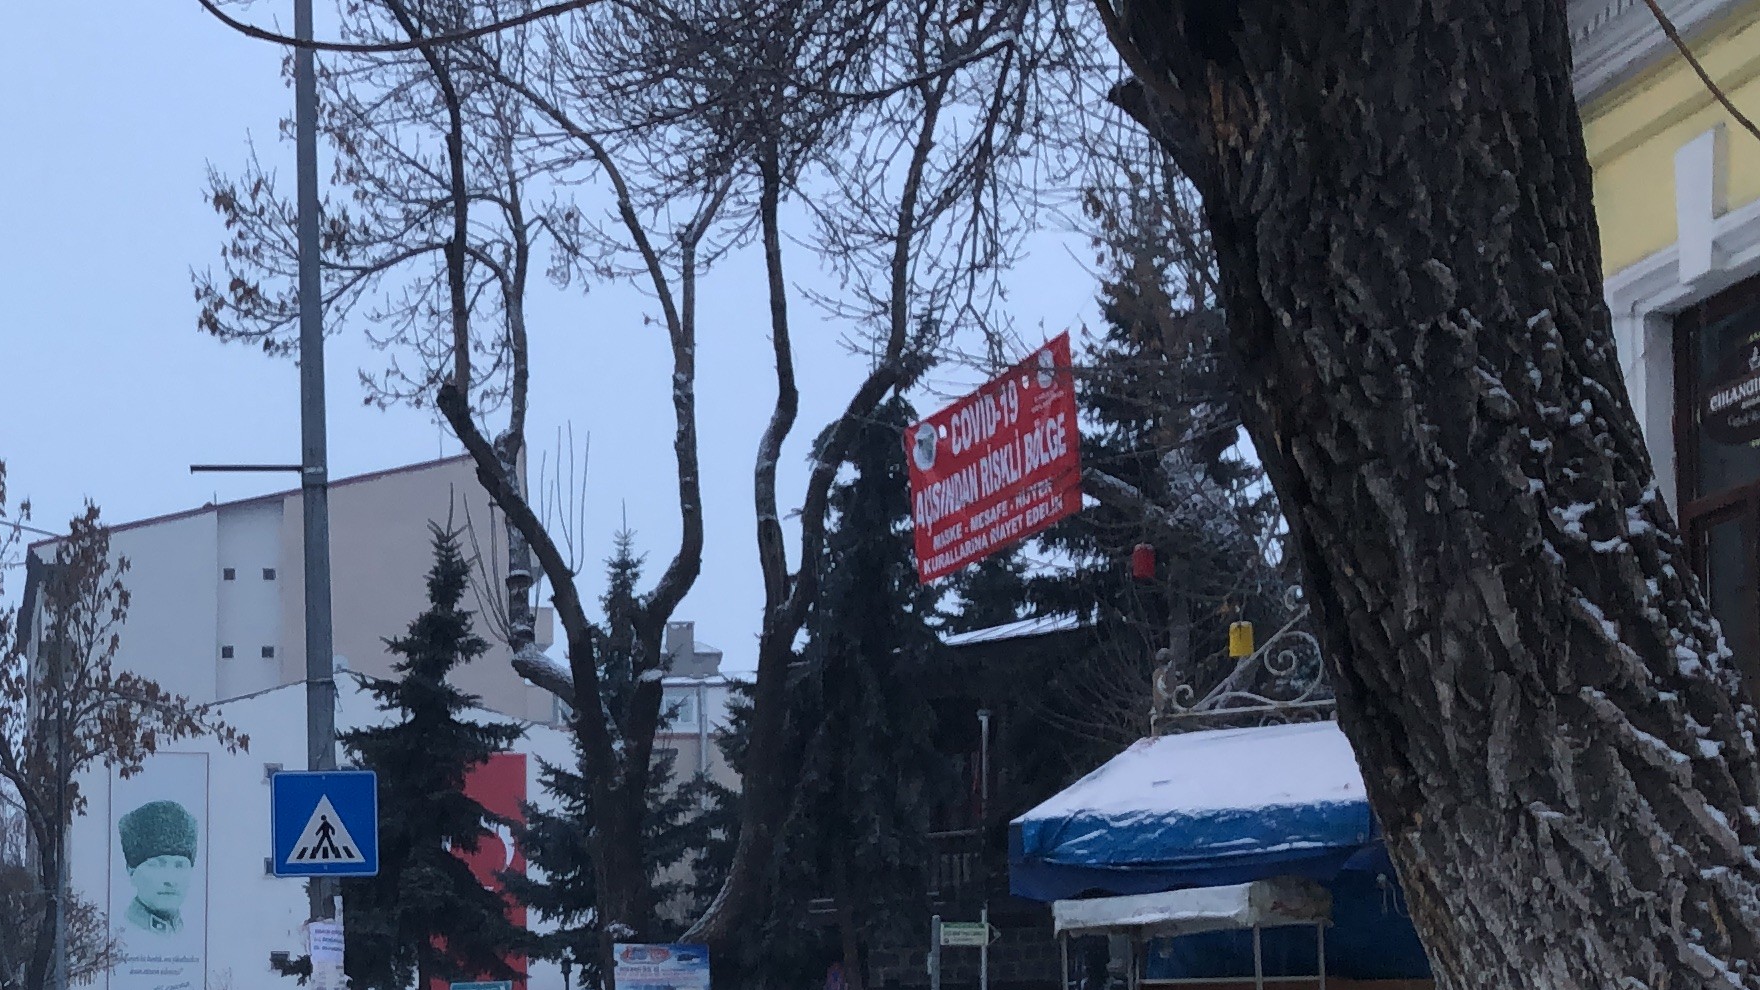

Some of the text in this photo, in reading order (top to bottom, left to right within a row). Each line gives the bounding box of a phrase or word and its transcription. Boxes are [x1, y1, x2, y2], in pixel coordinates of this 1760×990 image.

[915, 412, 1067, 536] AÇISINDAN RİSKLİ BÖLGE
